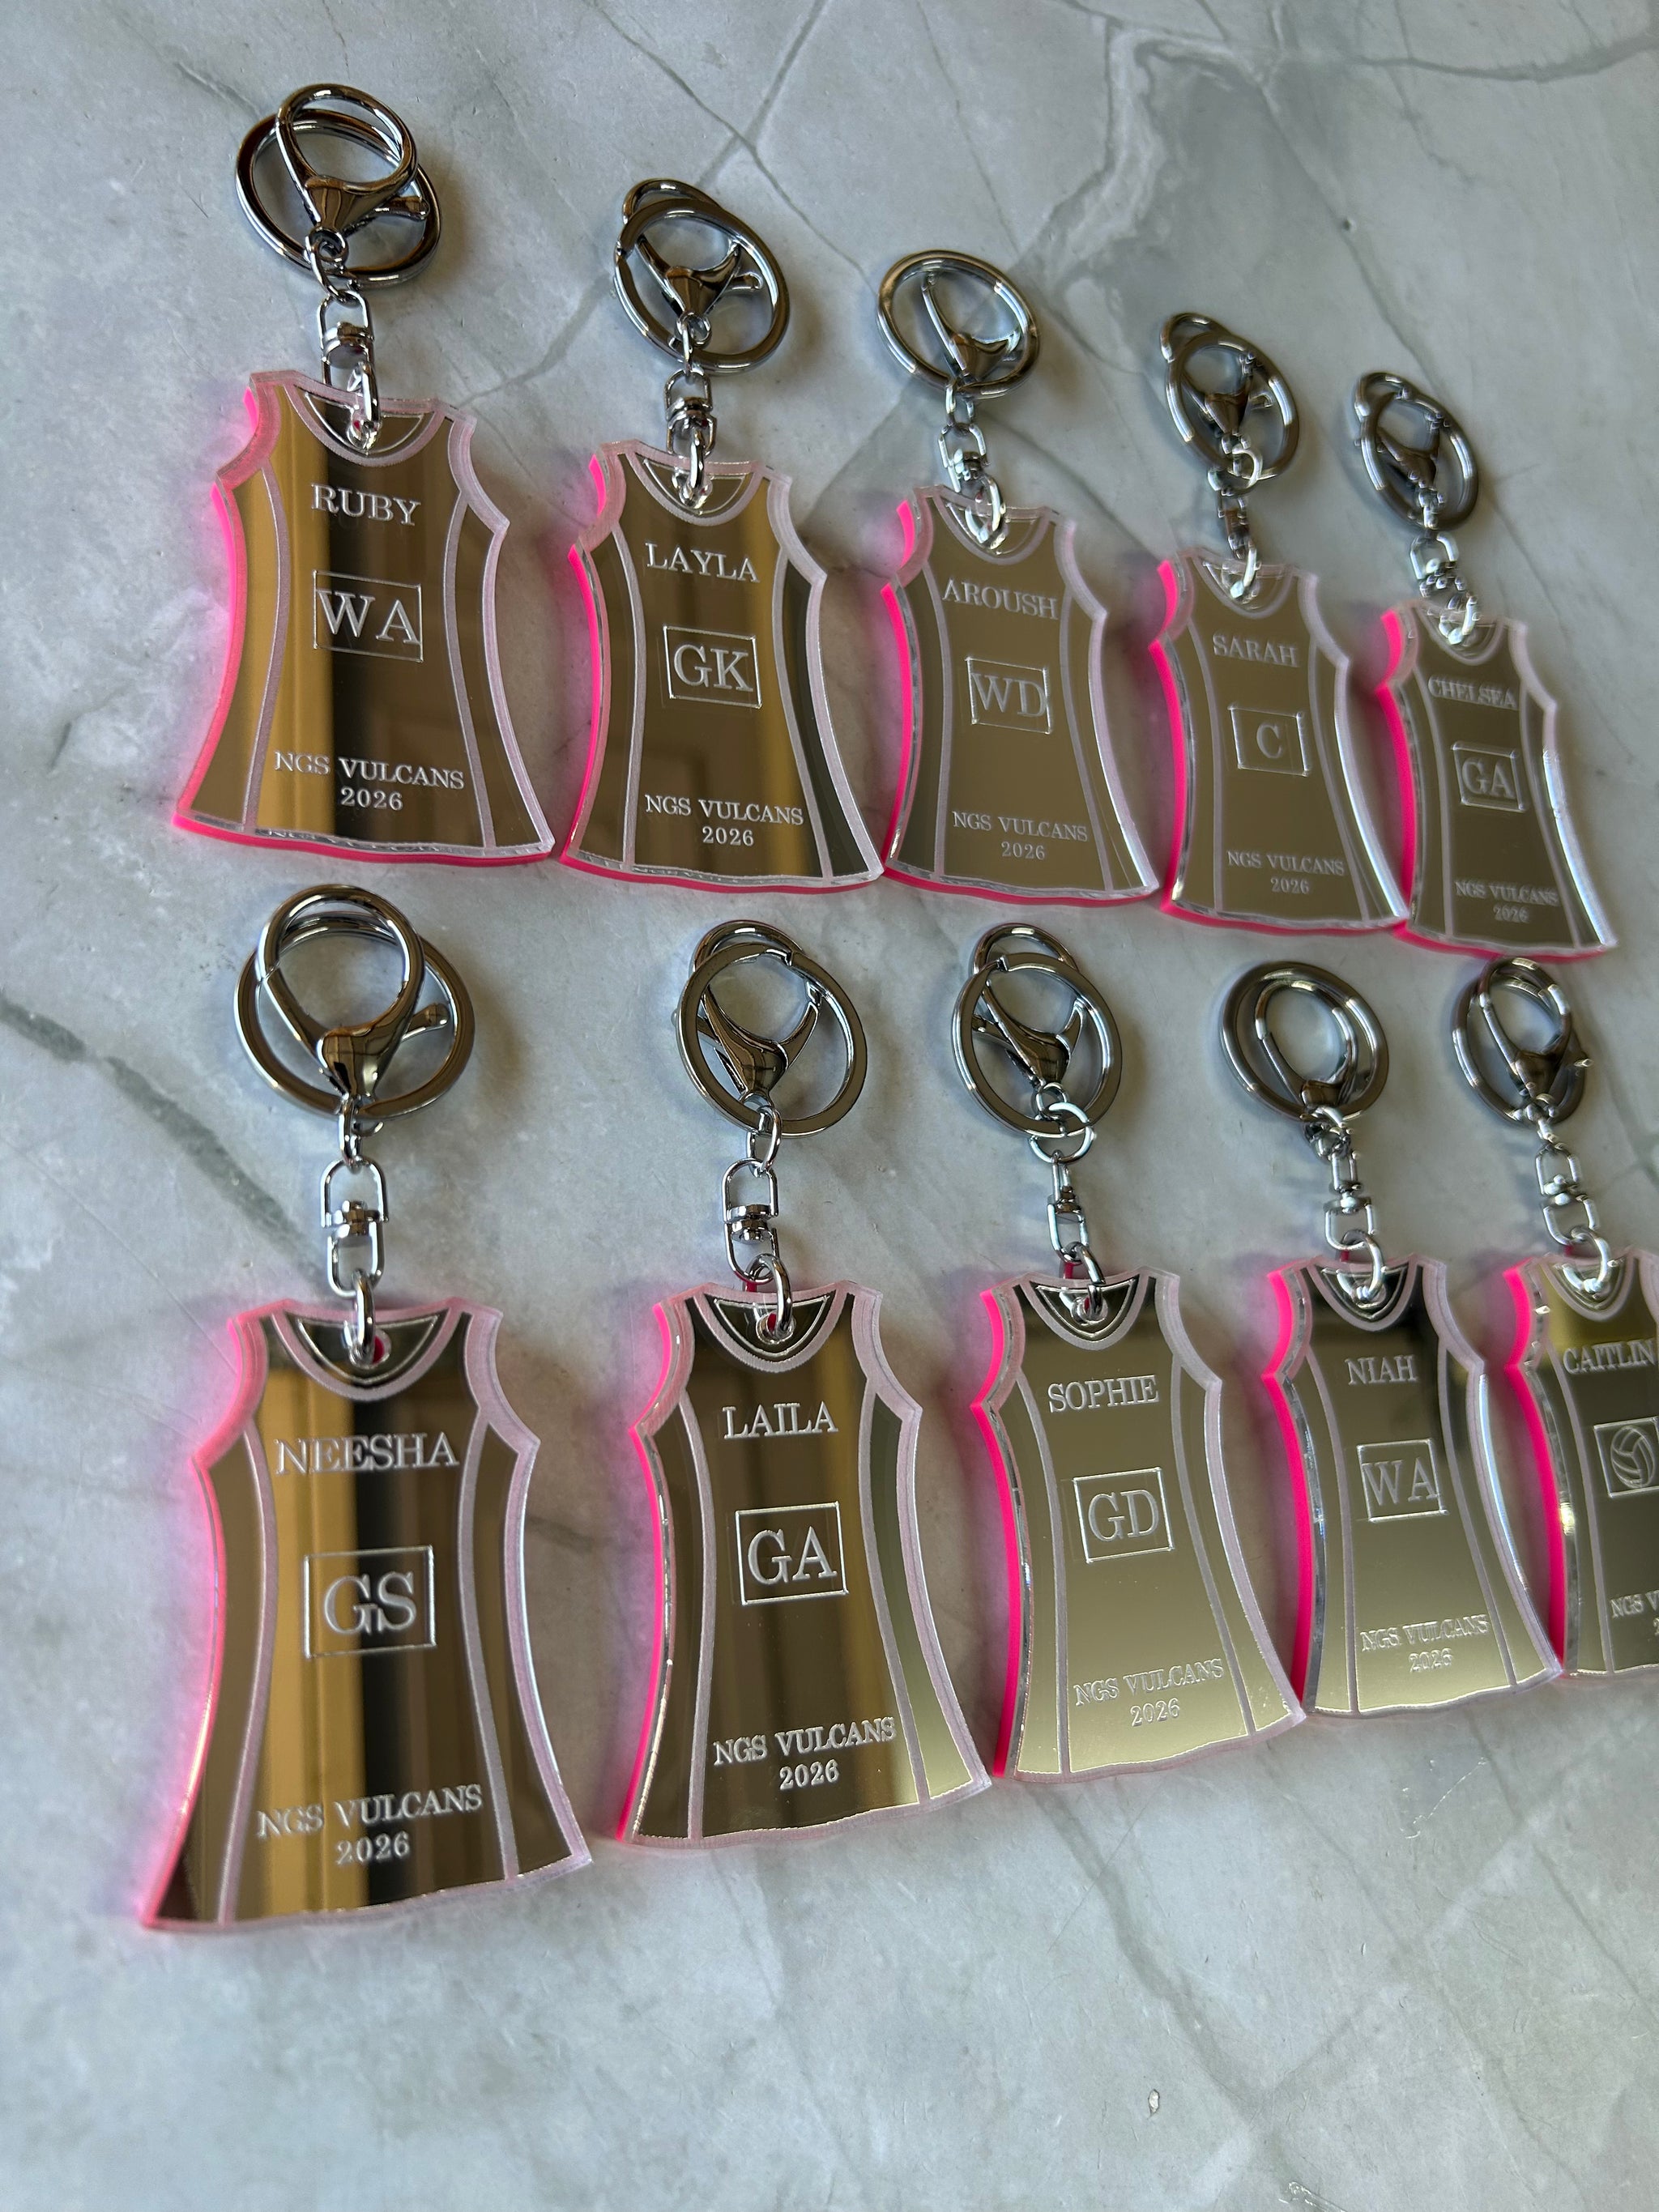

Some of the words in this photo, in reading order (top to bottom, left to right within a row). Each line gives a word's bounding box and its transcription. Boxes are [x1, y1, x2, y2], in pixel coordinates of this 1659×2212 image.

[311, 484, 420, 526] RUBY
[646, 543, 760, 583] LAYLA
[317, 590, 420, 645] WA
[942, 579, 1057, 619] AROUSH
[674, 644, 753, 691] GK
[1212, 635, 1299, 667] SARAH
[973, 673, 1047, 717] WD
[1428, 676, 1517, 710] CHELSEA
[1256, 722, 1282, 759] C
[274, 751, 330, 775] NGS
[339, 757, 465, 790] VULCANS
[1461, 757, 1516, 799] GA
[340, 787, 403, 810] 2026
[645, 795, 691, 816] NGS
[699, 799, 804, 826] VULCANS
[702, 826, 753, 846] 2026
[952, 811, 992, 831] NGS
[997, 816, 1088, 842] VULCANS
[1001, 841, 1045, 860] 2026
[1227, 852, 1261, 869] NGS
[1266, 855, 1345, 876] VULCANS
[1270, 878, 1309, 894] 2026
[1455, 880, 1485, 898] NGS
[1489, 884, 1559, 906] VULCANS
[1493, 906, 1529, 923] 2026
[1345, 1354, 1417, 1385] NIAH
[1563, 1337, 1657, 1375] CAITLIN
[1048, 1375, 1159, 1413] SOPHIE
[722, 1401, 838, 1439] LAILA
[275, 1433, 459, 1476] NEESHA
[1362, 1457, 1439, 1507] WA
[1088, 1489, 1159, 1542] GD
[748, 1527, 837, 1585] GA
[325, 1571, 417, 1635] GS
[1610, 1593, 1644, 1618] NGS
[1360, 1627, 1401, 1652] NGS
[1401, 1614, 1490, 1645] VULCANS
[1409, 1648, 1453, 1672] 2026
[1074, 1677, 1120, 1707] NGS
[1123, 1659, 1224, 1696] VULCANS
[1130, 1698, 1180, 1728] 2026
[713, 1737, 767, 1767] NGS
[774, 1717, 898, 1757] VULCANS
[778, 1761, 840, 1791] 2026
[257, 1804, 323, 1839] NGS
[332, 1784, 483, 1828] VULCANS
[336, 1832, 412, 1865] 2026
